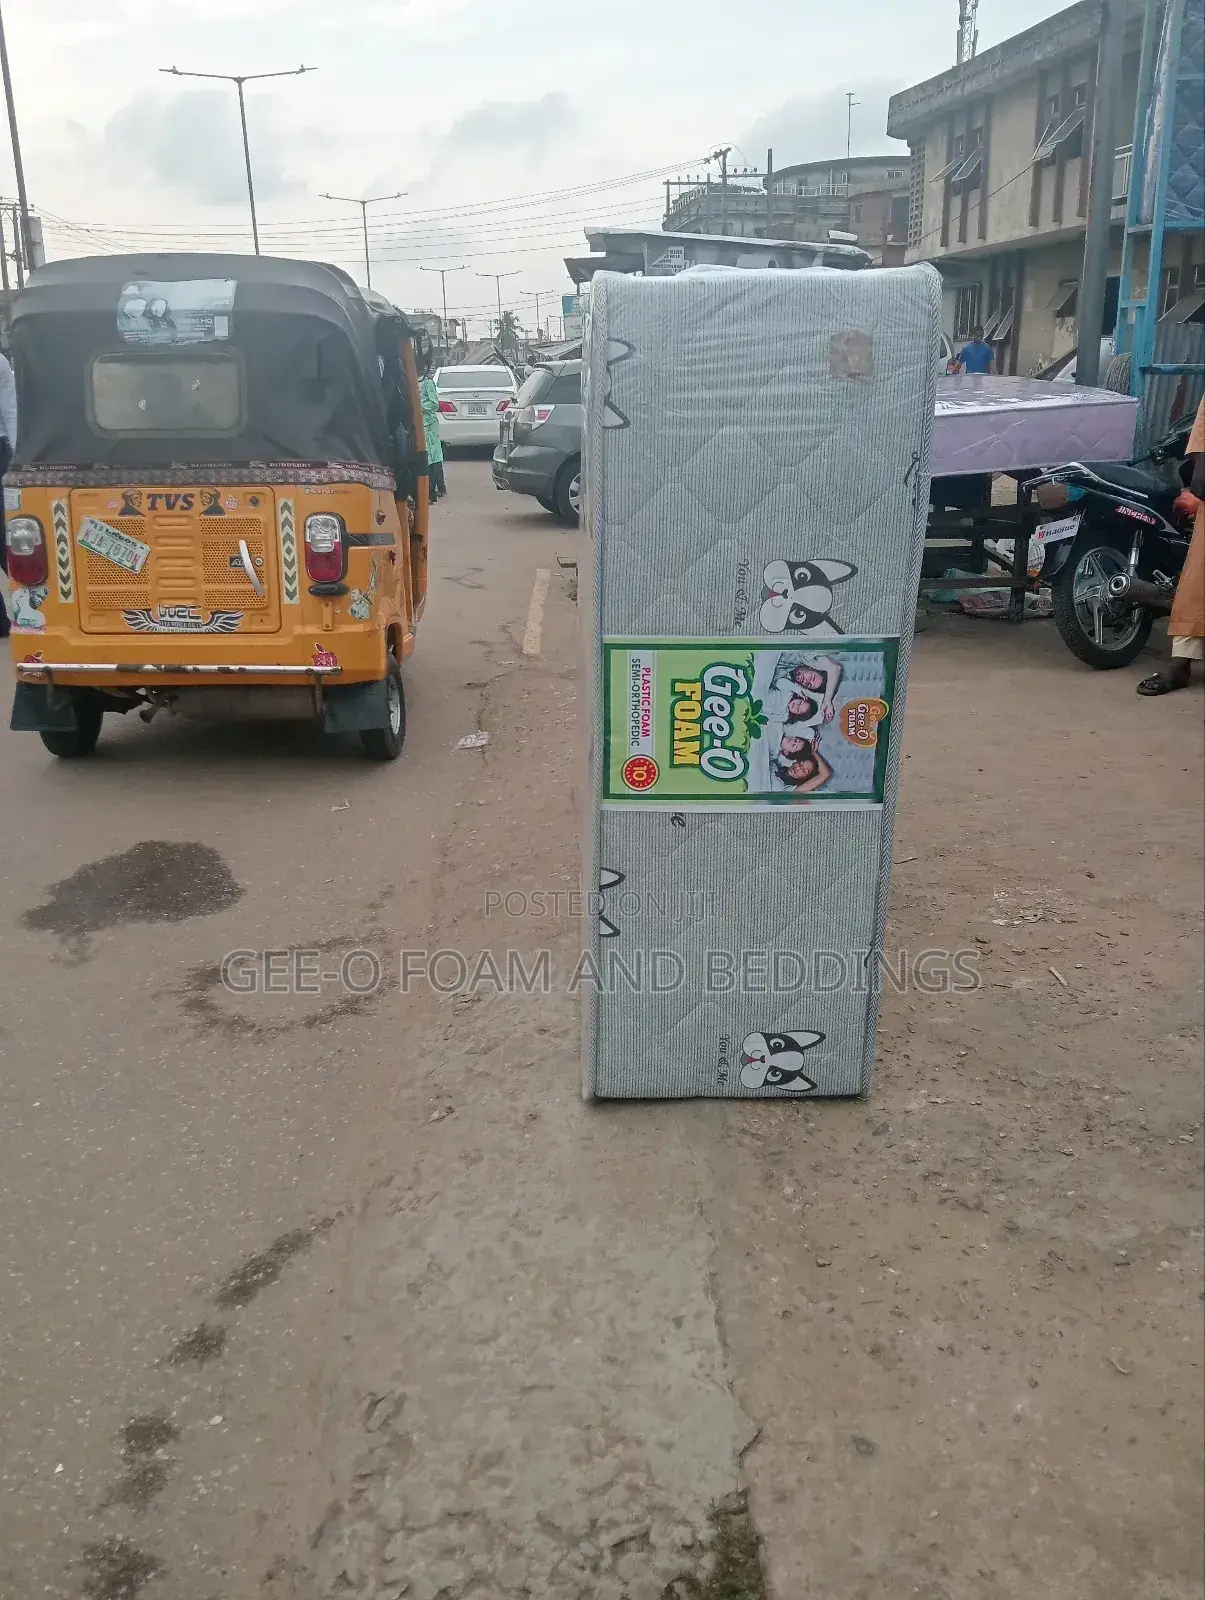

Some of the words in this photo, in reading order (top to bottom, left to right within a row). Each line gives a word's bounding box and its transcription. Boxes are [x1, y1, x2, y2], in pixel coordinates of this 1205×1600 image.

[146, 493, 196, 511] TVS
[631, 658, 641, 747] SEMI-ORTHOPEDIC
[641, 667, 651, 705] PLASTIC
[641, 708, 651, 738] FOAM
[673, 681, 702, 765] FOAM
[700, 663, 749, 781] Gee-O
[848, 708, 856, 736] FOAM
[857, 703, 869, 740] Gee-O
[632, 765, 647, 781] 10
